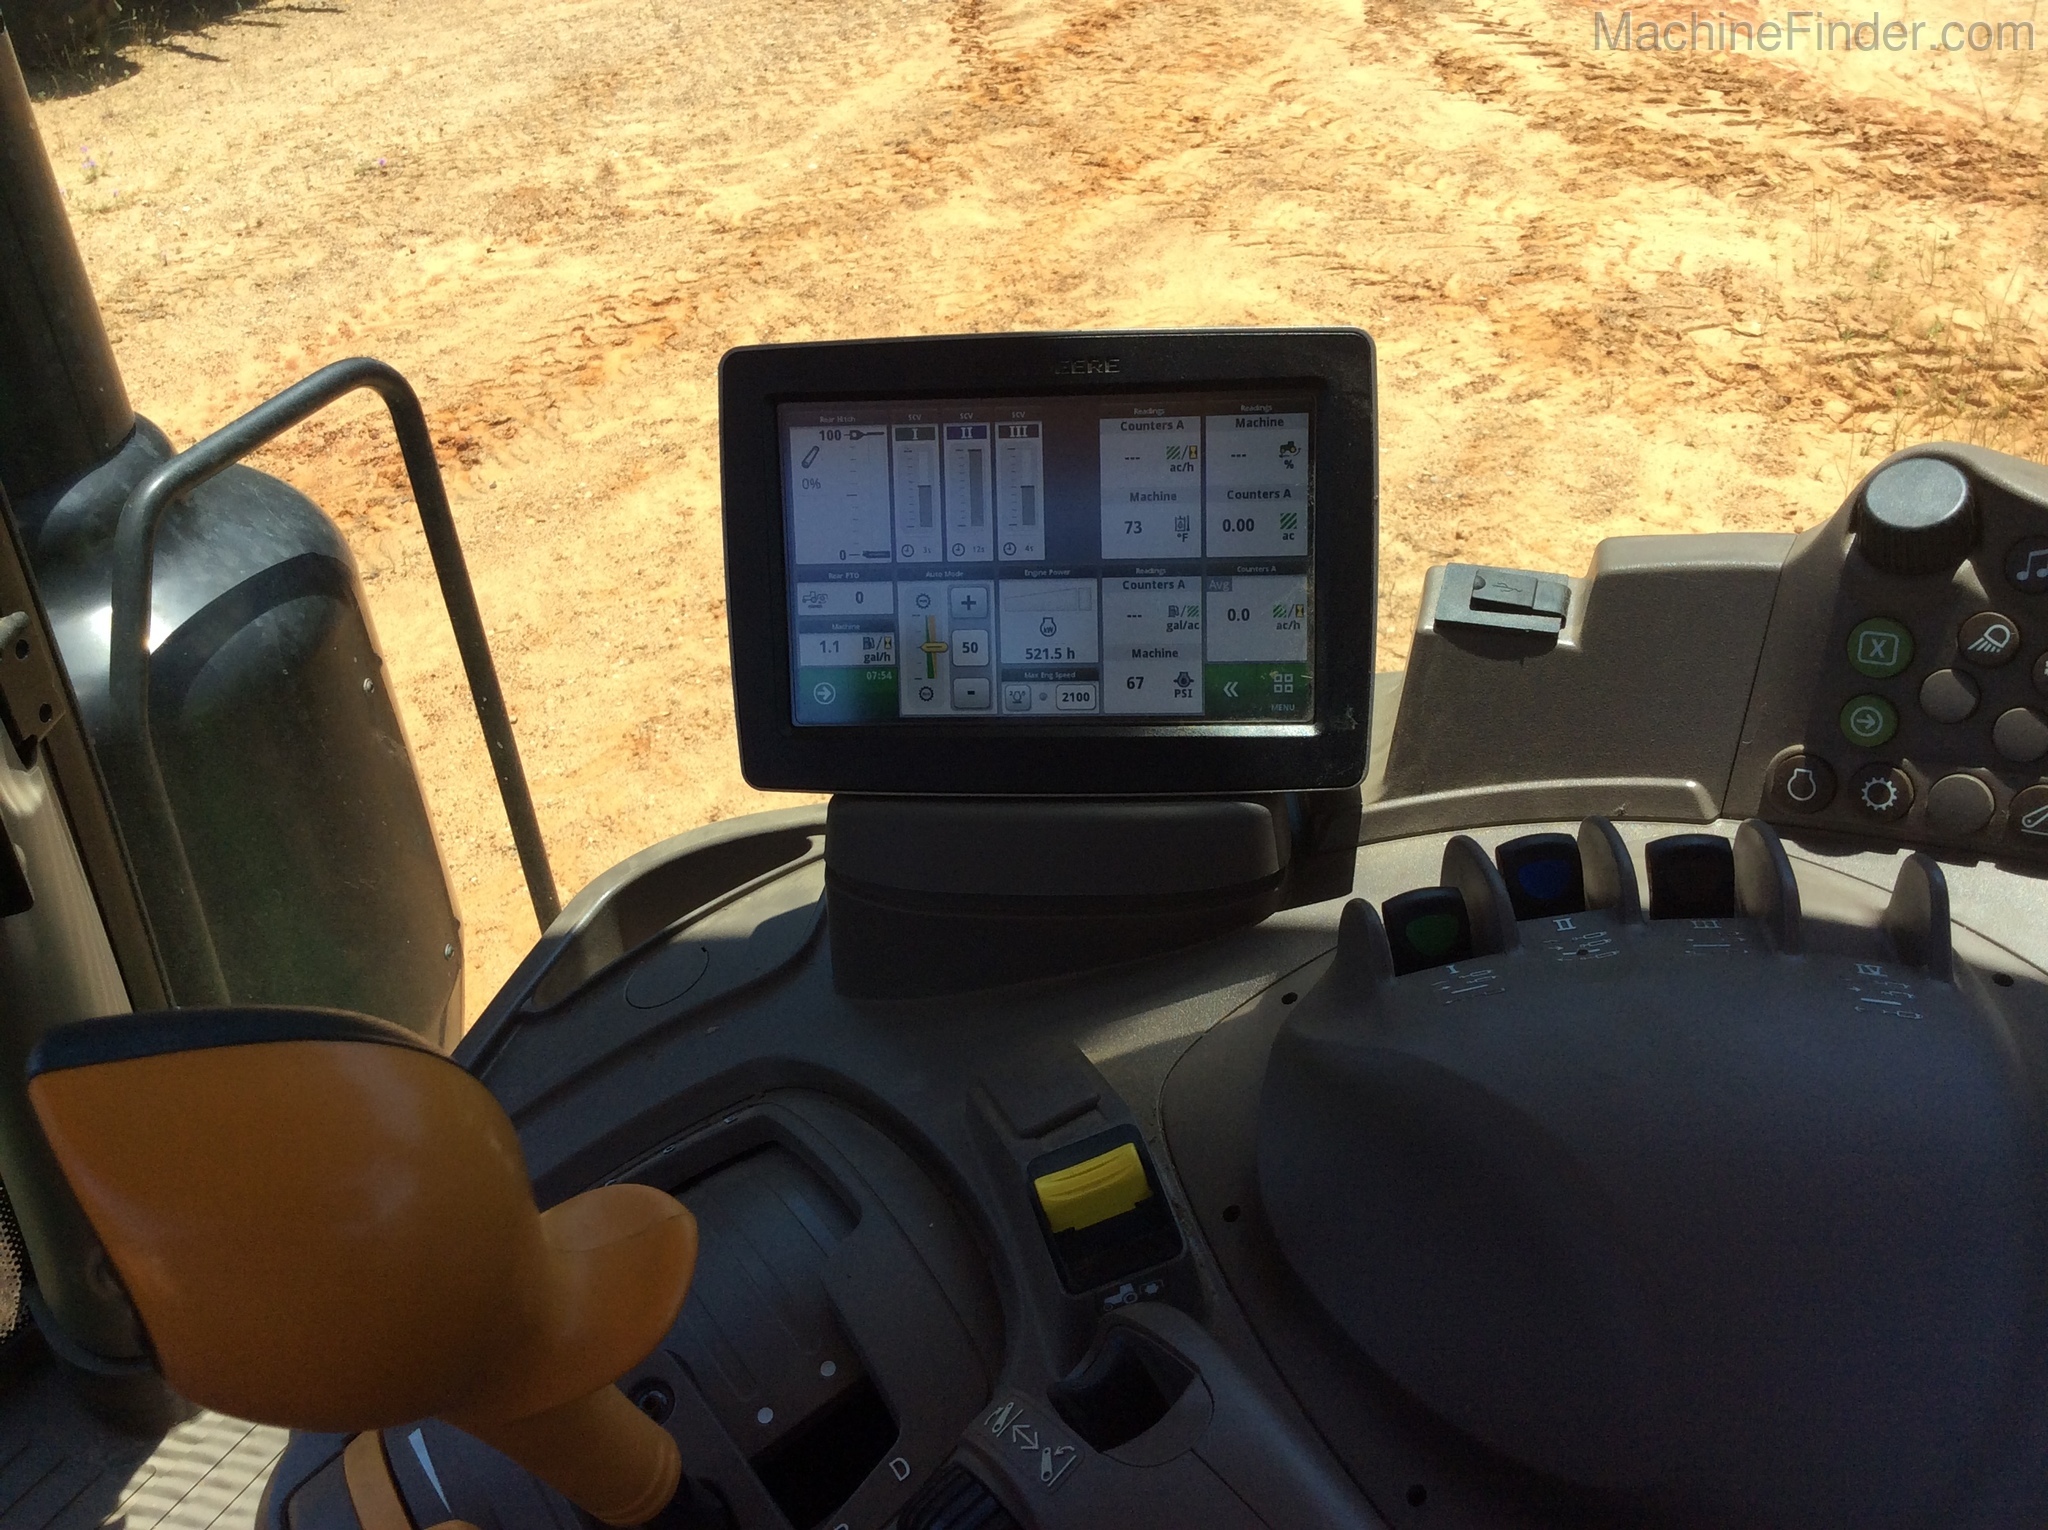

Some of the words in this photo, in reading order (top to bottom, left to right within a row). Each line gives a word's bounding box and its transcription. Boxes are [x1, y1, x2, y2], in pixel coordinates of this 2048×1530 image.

[1134, 408, 1166, 416] Readings
[1240, 404, 1272, 413] Readings
[820, 415, 835, 424] Rear
[837, 414, 856, 423] Hitch
[908, 413, 922, 421] SCV
[960, 412, 974, 420] SCV
[1012, 411, 1026, 419] SCV
[1120, 421, 1174, 432] Counters
[1176, 420, 1184, 430] A
[1235, 418, 1284, 428] Machine
[819, 430, 842, 441] 100
[961, 427, 974, 438] II
[1009, 426, 1028, 438] III
[1170, 462, 1194, 473] ac/h
[1284, 460, 1295, 470] %
[802, 478, 822, 490] 0%
[1130, 491, 1177, 502] Machine
[1227, 490, 1280, 500] Counters
[1283, 489, 1292, 499] A
[1124, 520, 1143, 535] 73
[1222, 518, 1255, 532] 0.00
[1282, 532, 1295, 541] ac
[839, 550, 846, 561] 0
[828, 572, 843, 580] Rear
[845, 572, 860, 580] PTO
[944, 570, 964, 578] Mode
[1024, 569, 1046, 578] Engine
[1049, 568, 1071, 576] Power
[1136, 568, 1166, 576] Readings
[1122, 580, 1175, 590] Counters
[1178, 580, 1186, 589] A
[1209, 579, 1230, 592] Avg
[855, 591, 864, 604] 0
[1227, 608, 1250, 622] 0.0
[832, 623, 861, 631] Machine
[1166, 620, 1200, 633] gal/ac
[1276, 619, 1301, 631] ac/h
[820, 640, 840, 654] 1.1
[962, 642, 978, 654] 50
[864, 652, 891, 665] gal/h
[1025, 648, 1063, 660] 521.5
[1066, 648, 1076, 660] h
[1132, 648, 1179, 659] Machine
[866, 670, 892, 681] 07:54
[1040, 672, 1054, 680] Eng
[1055, 672, 1076, 680] Speed
[1126, 676, 1145, 690] 67
[1062, 692, 1090, 703] 2100
[1174, 689, 1193, 699] PSI
[1272, 704, 1295, 712] MENU
[889, 1457, 911, 1482] D
